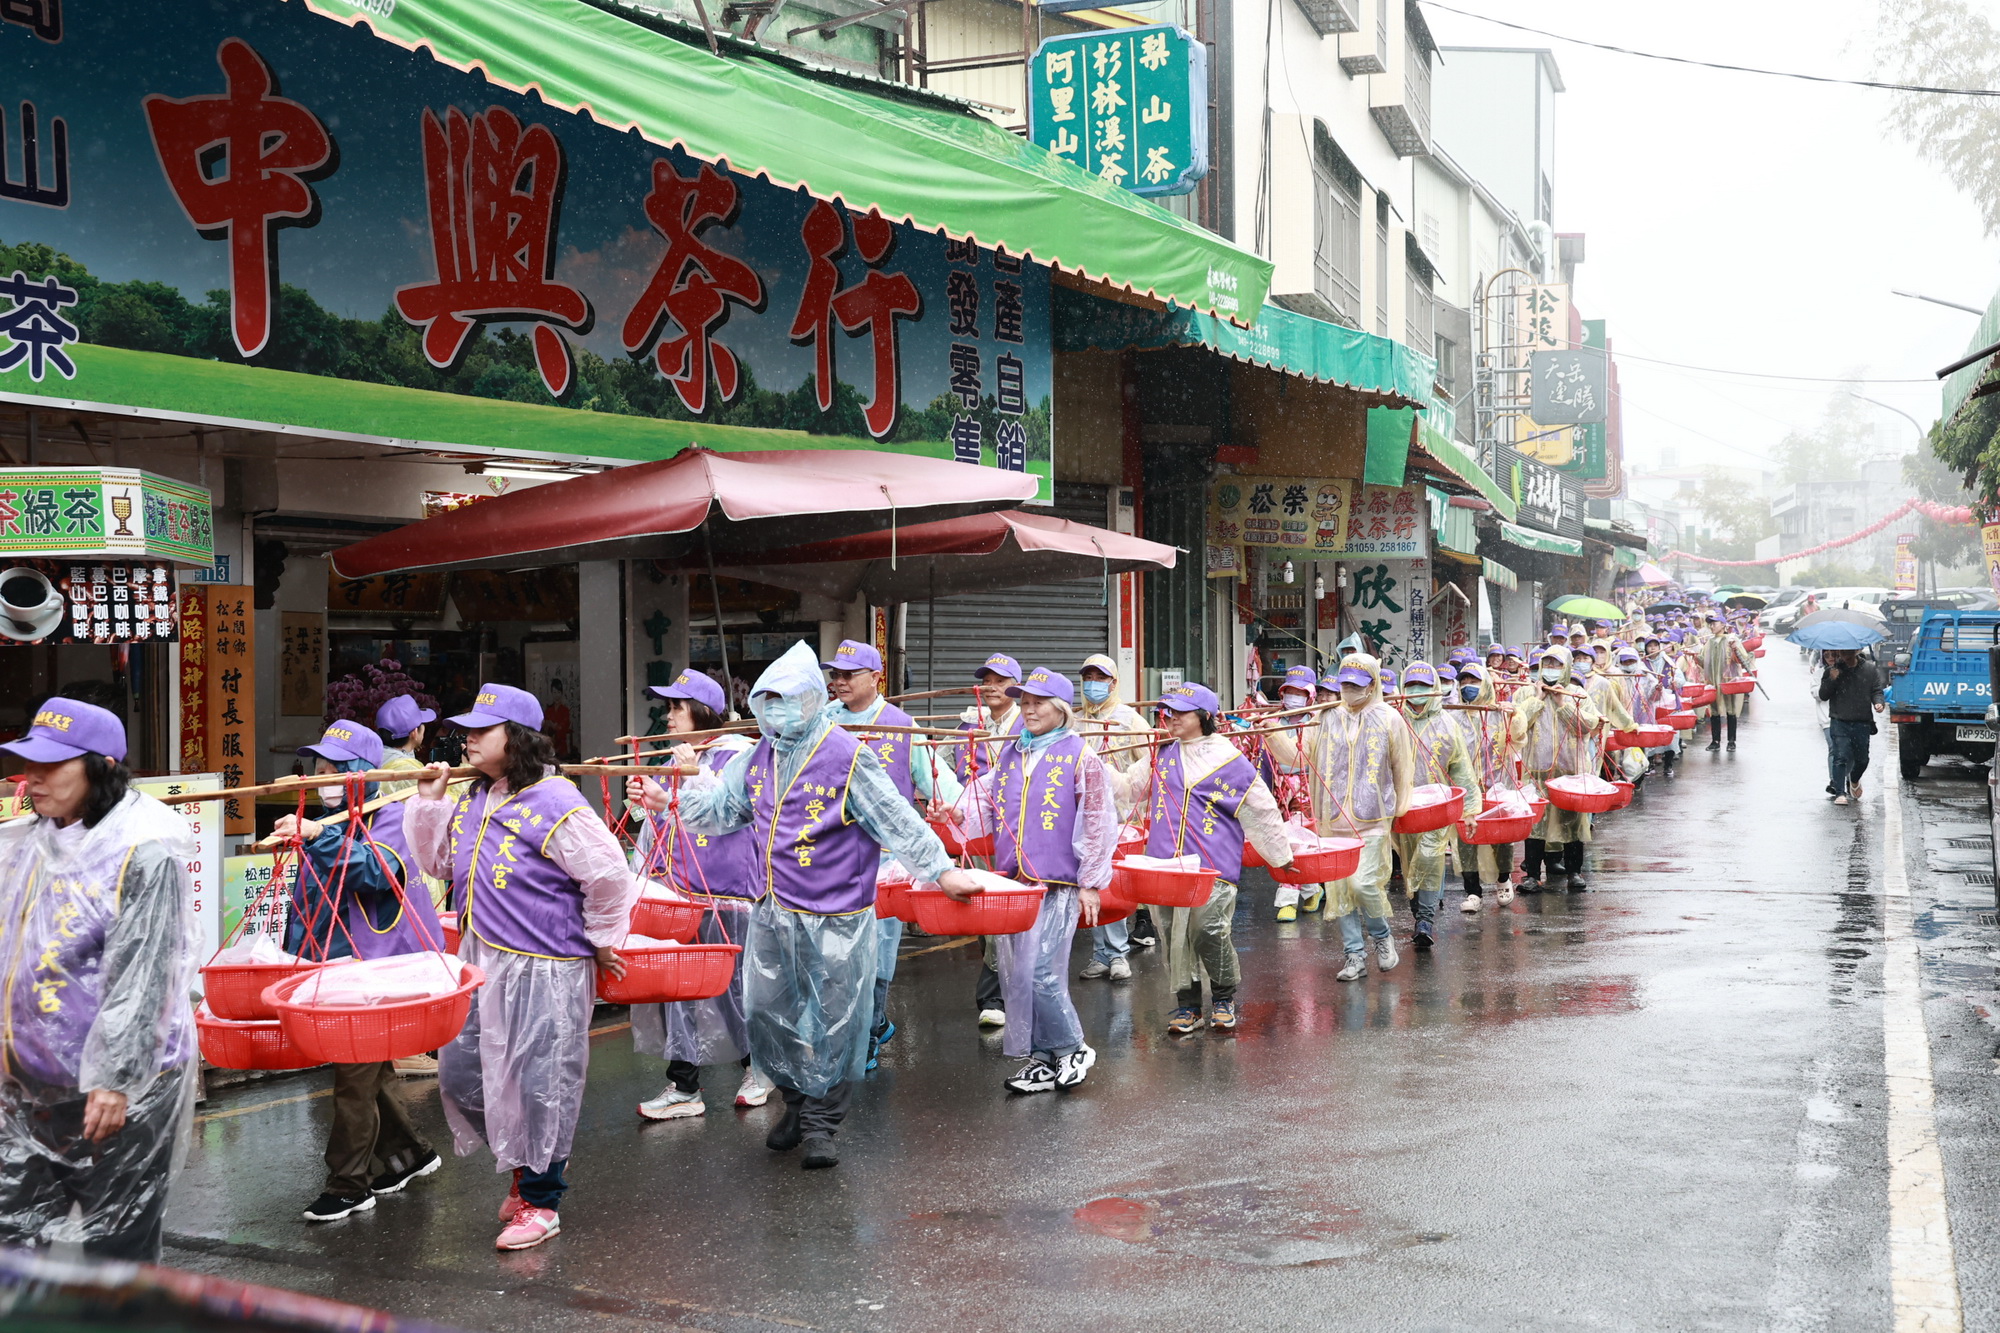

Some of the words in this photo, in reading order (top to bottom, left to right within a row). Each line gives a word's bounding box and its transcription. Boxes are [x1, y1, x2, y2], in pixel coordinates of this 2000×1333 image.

[1046, 50, 1078, 165] 阿里山
[1091, 41, 1128, 186] 杉林溪茶
[1139, 32, 1176, 184] 梨山茶
[143, 36, 921, 443] 中興茶行
[206, 566, 226, 581] 113
[1380, 541, 1417, 551] 2581867
[70, 566, 89, 639] 藍山咖啡
[112, 567, 131, 639] 巴西咖啡
[132, 567, 151, 639] 摩卡咖啡
[152, 567, 171, 638] 拿鐵咖啡
[216, 601, 230, 656] 松山村
[233, 600, 247, 657] 名間鄉
[182, 597, 204, 758] 五路財神年年到
[1923, 682, 1949, 695] AW
[184, 802, 201, 815] 35
[803, 782, 837, 800] 松柏嶺
[1040, 765, 1064, 831] 受天宮
[1202, 790, 1225, 835] 受天宮
[793, 799, 826, 867] 受天宮
[244, 864, 297, 882] 松柏玉
